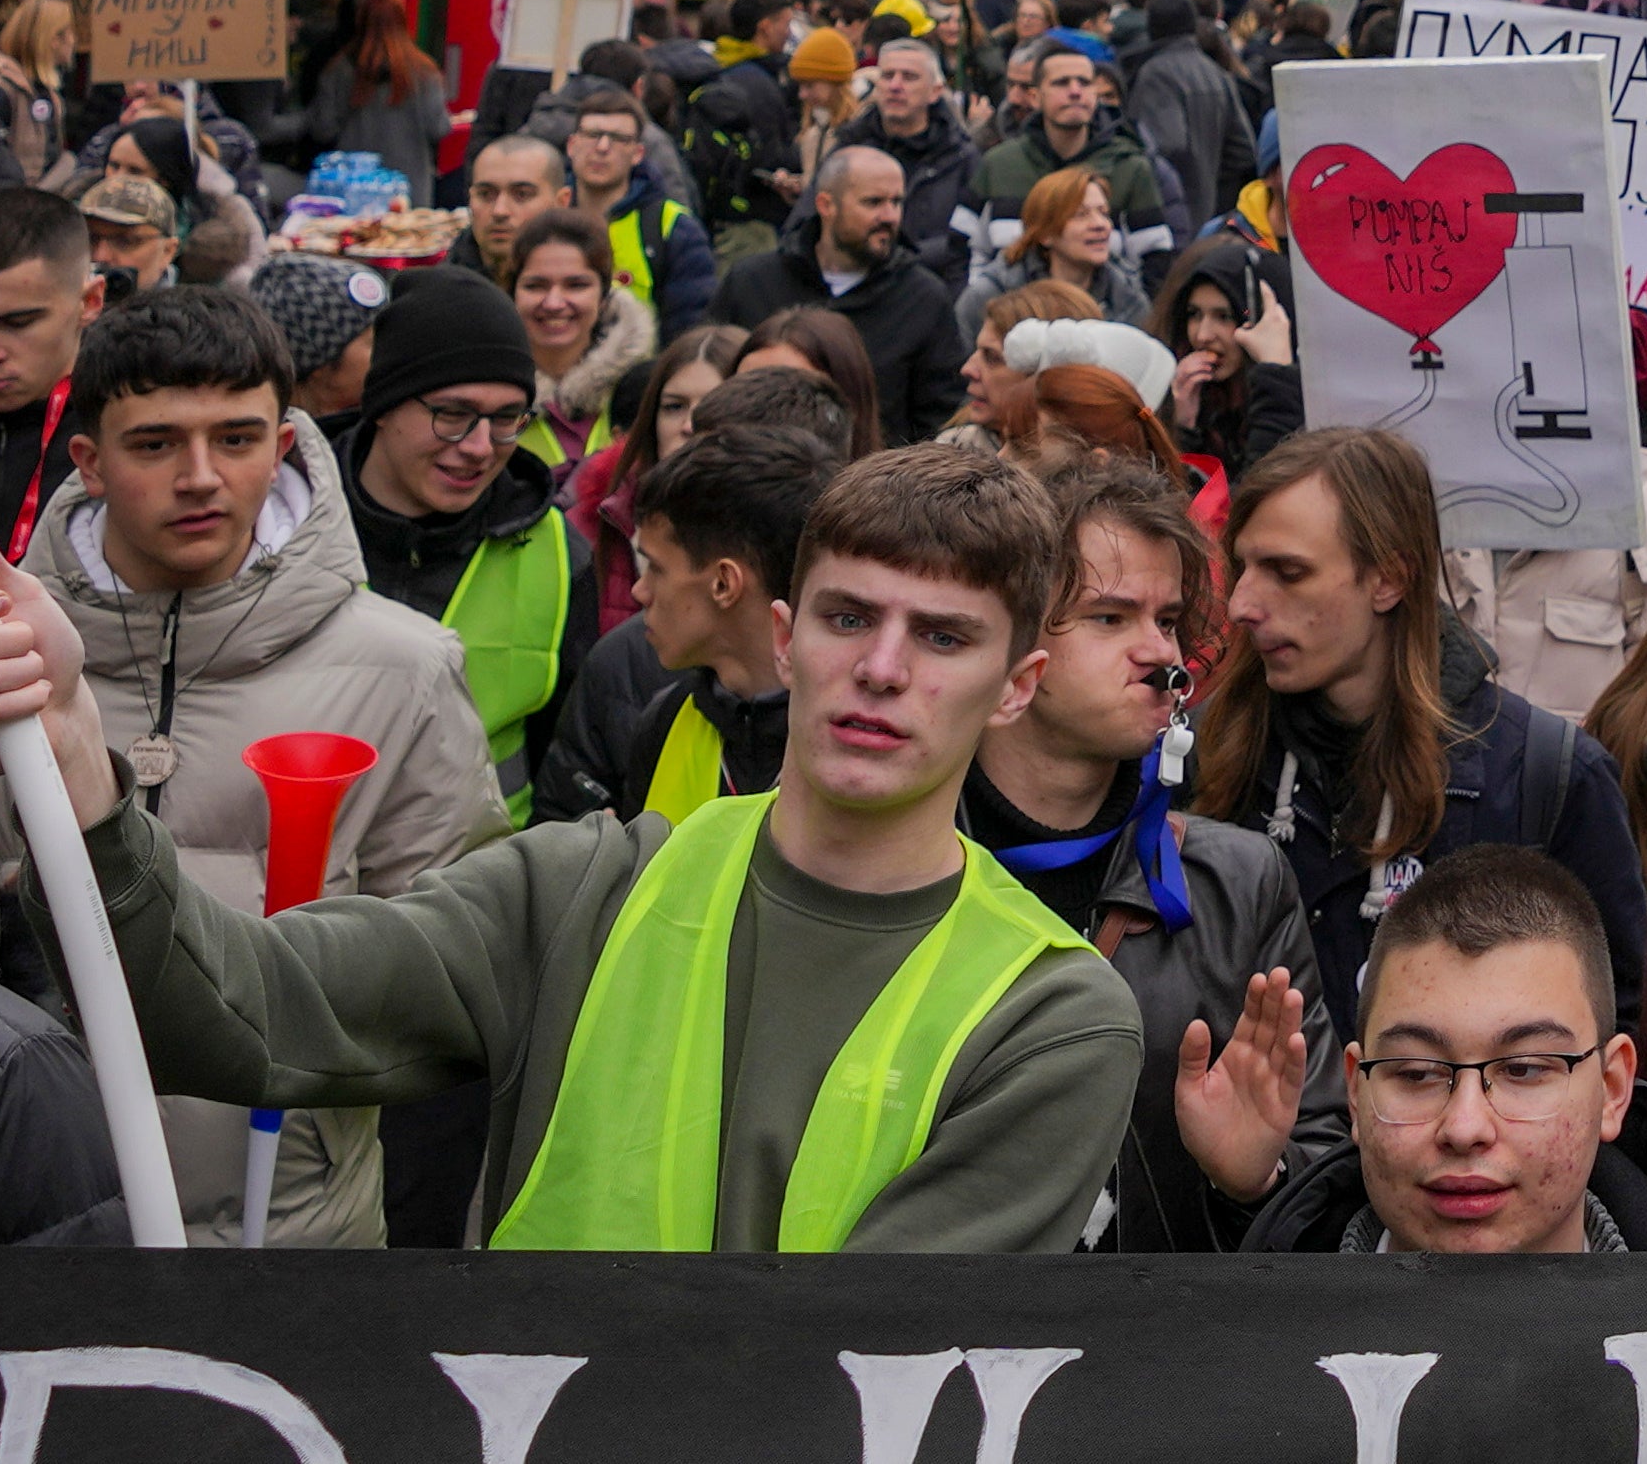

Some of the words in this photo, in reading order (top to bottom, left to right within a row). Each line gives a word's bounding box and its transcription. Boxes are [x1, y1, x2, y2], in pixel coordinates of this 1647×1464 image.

[127, 35, 208, 68] НИШ
[1348, 195, 1472, 245] PUMPAJ
[1384, 244, 1453, 296] NIŠ
